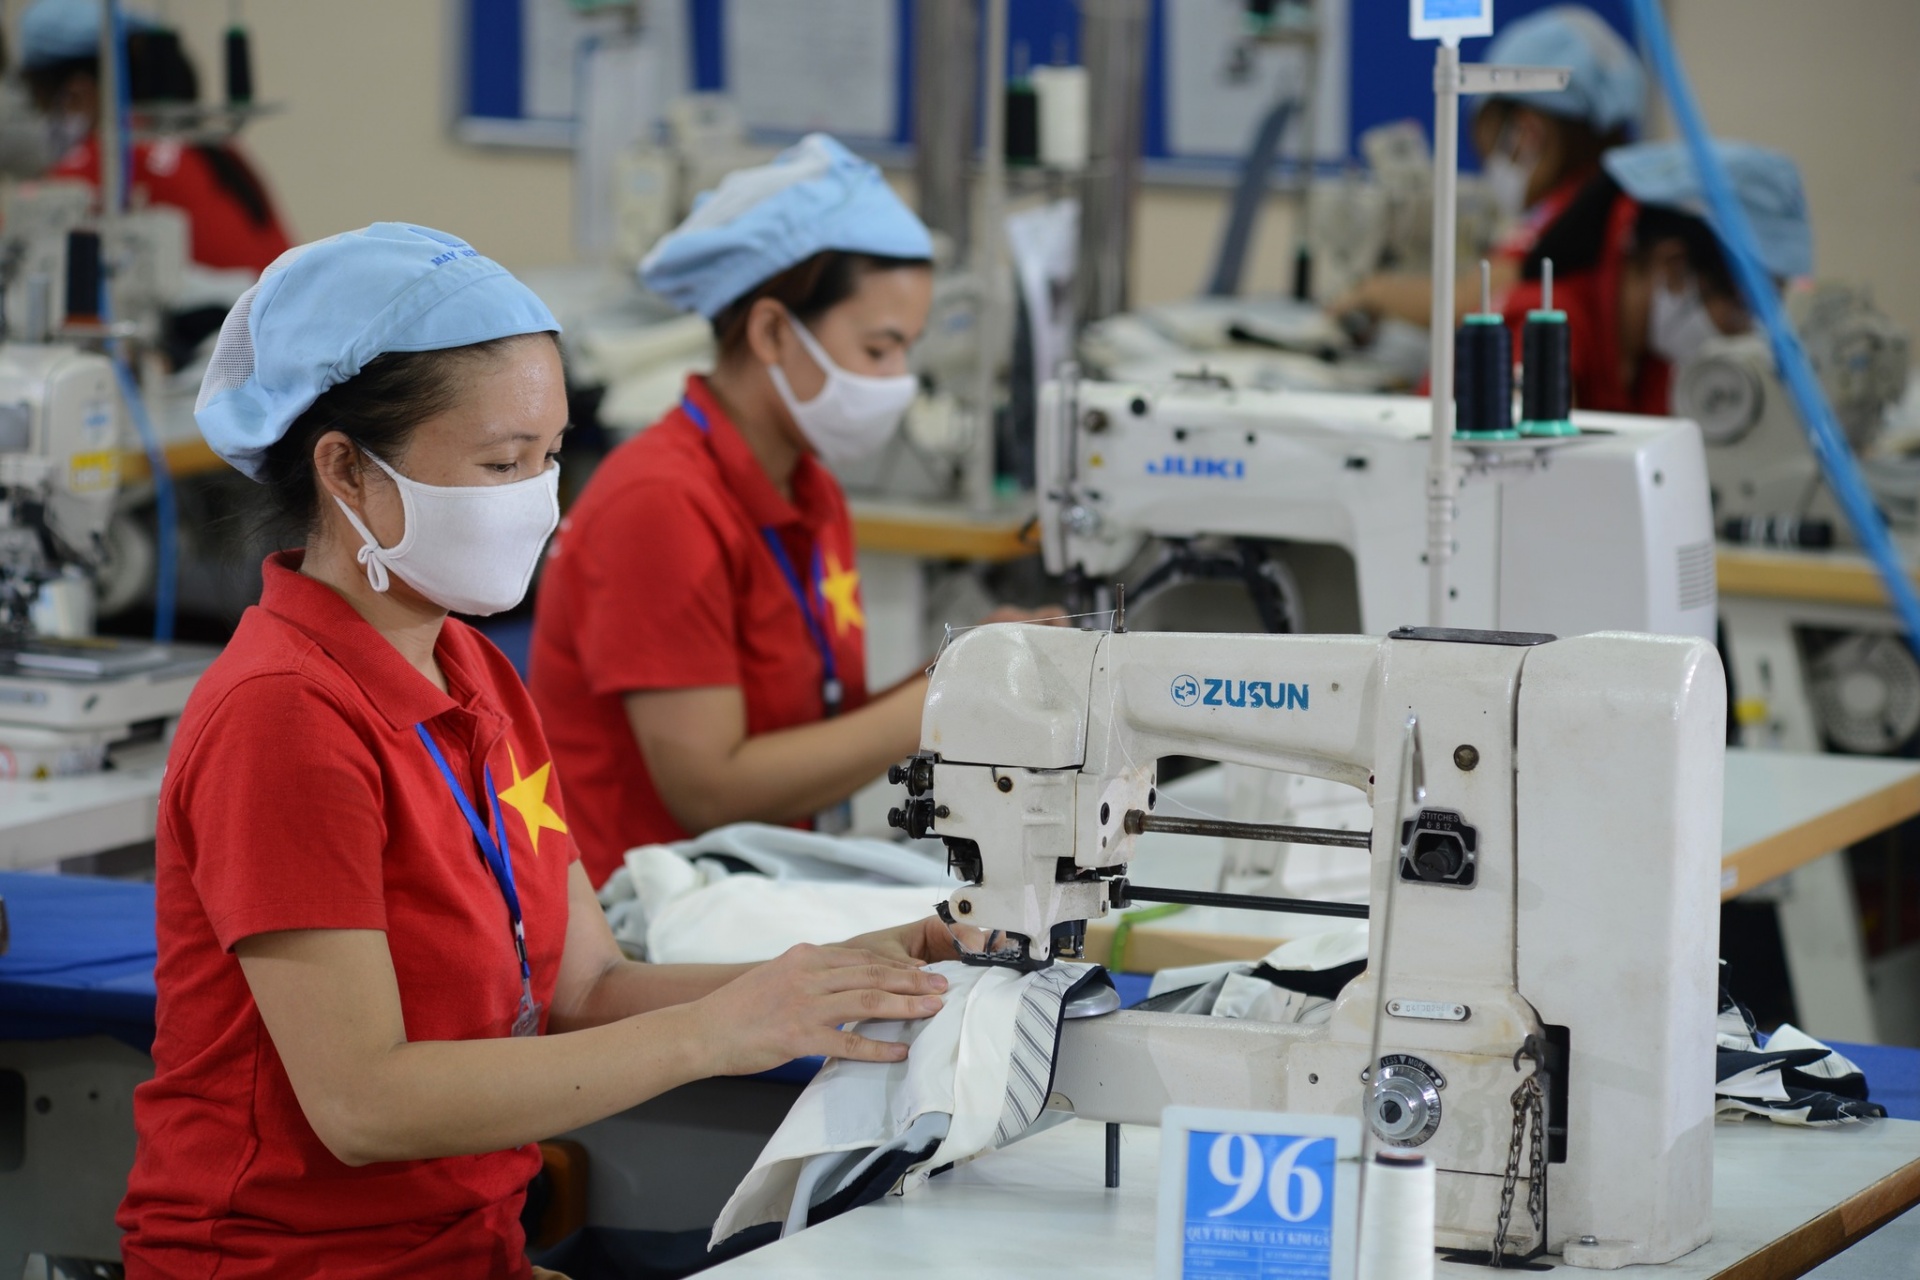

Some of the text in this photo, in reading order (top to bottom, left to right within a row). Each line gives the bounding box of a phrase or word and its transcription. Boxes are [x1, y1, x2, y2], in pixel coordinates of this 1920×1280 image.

[431, 251, 458, 266] MAY
[1146, 456, 1245, 479] JUKI
[1203, 678, 1309, 710] ZUSUN
[1420, 811, 1459, 823] STITCHES
[1435, 822, 1441, 830] 8
[1443, 823, 1452, 831] 12
[1381, 1056, 1427, 1072] LESS MORE
[1208, 1133, 1325, 1222] 96
